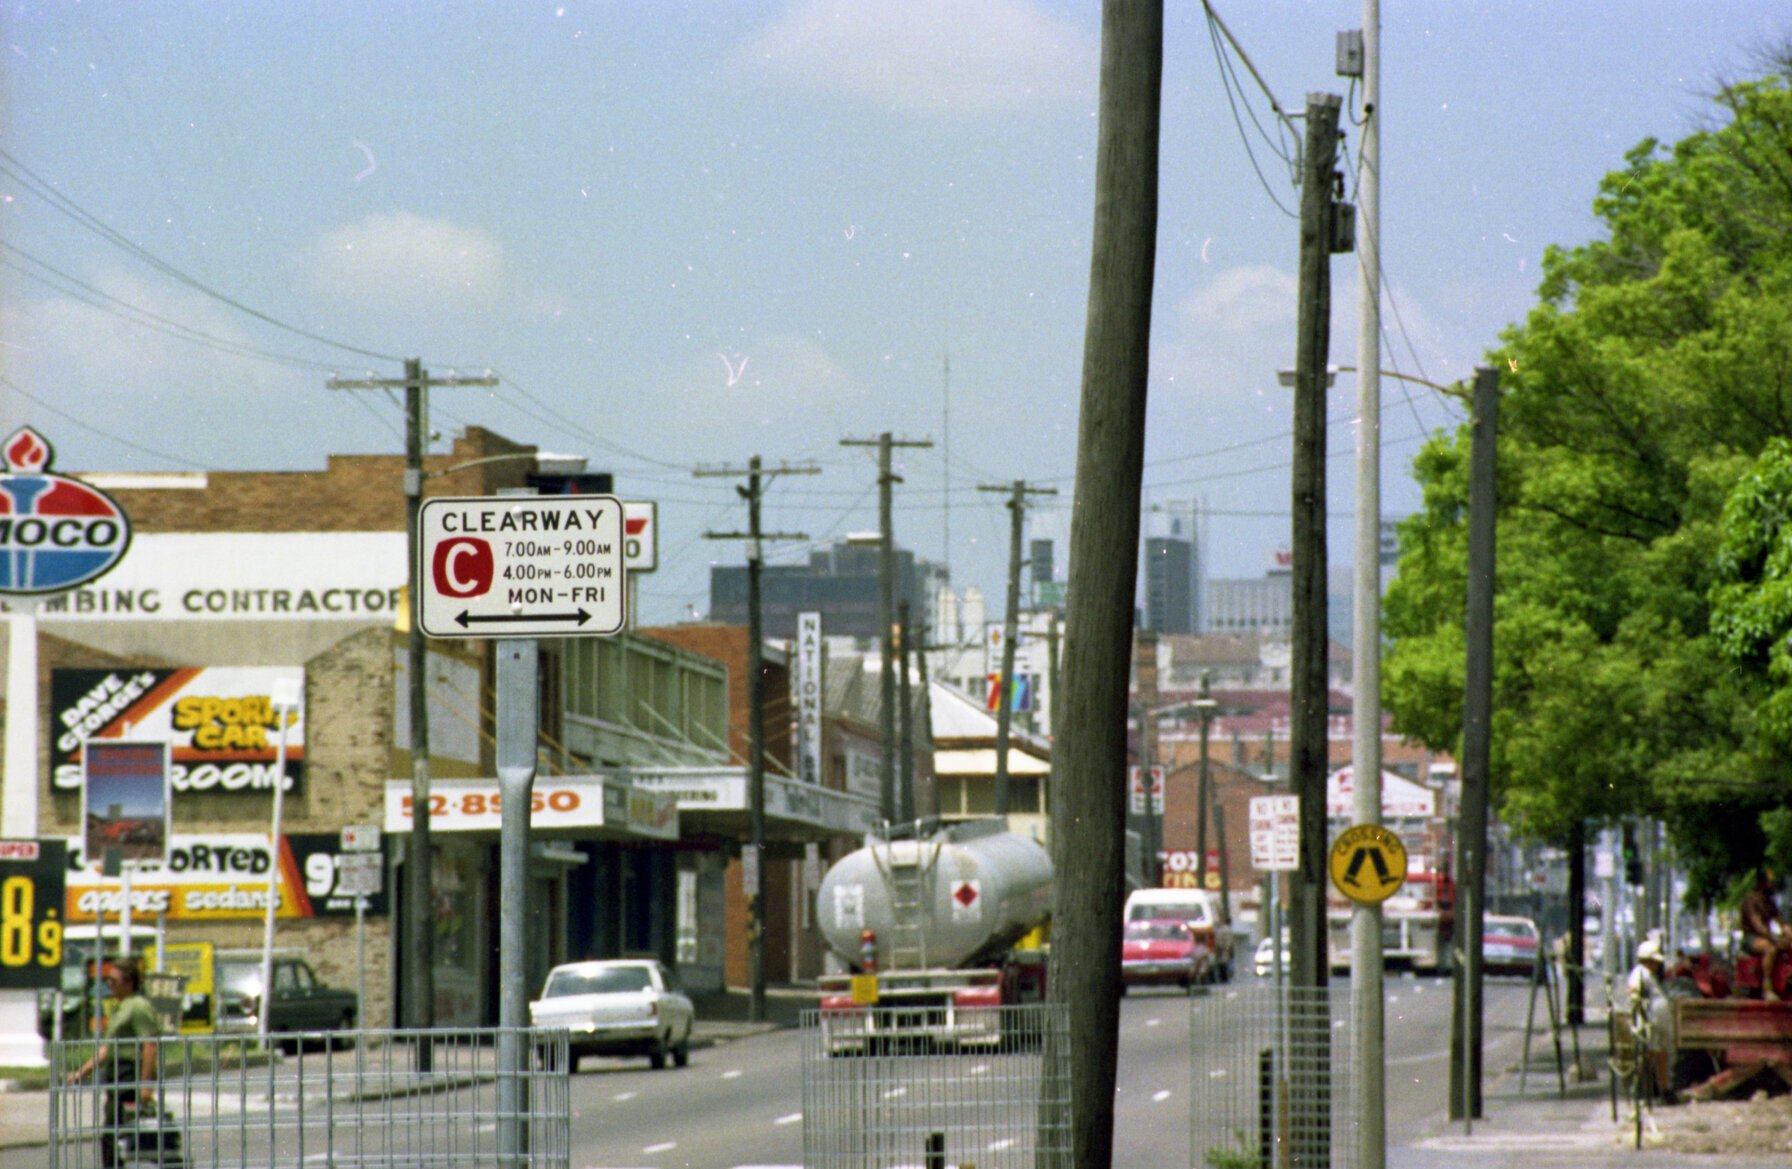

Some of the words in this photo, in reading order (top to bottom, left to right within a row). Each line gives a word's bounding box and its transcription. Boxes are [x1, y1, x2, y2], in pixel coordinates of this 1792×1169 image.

[441, 510, 604, 532] CLEARWAY
[445, 542, 478, 594] C
[803, 619, 816, 742] NATIONAL
[61, 673, 124, 728] DAVE
[191, 723, 270, 750] CAR
[1336, 826, 1400, 856] CROSSING
[185, 883, 281, 909] sedans
